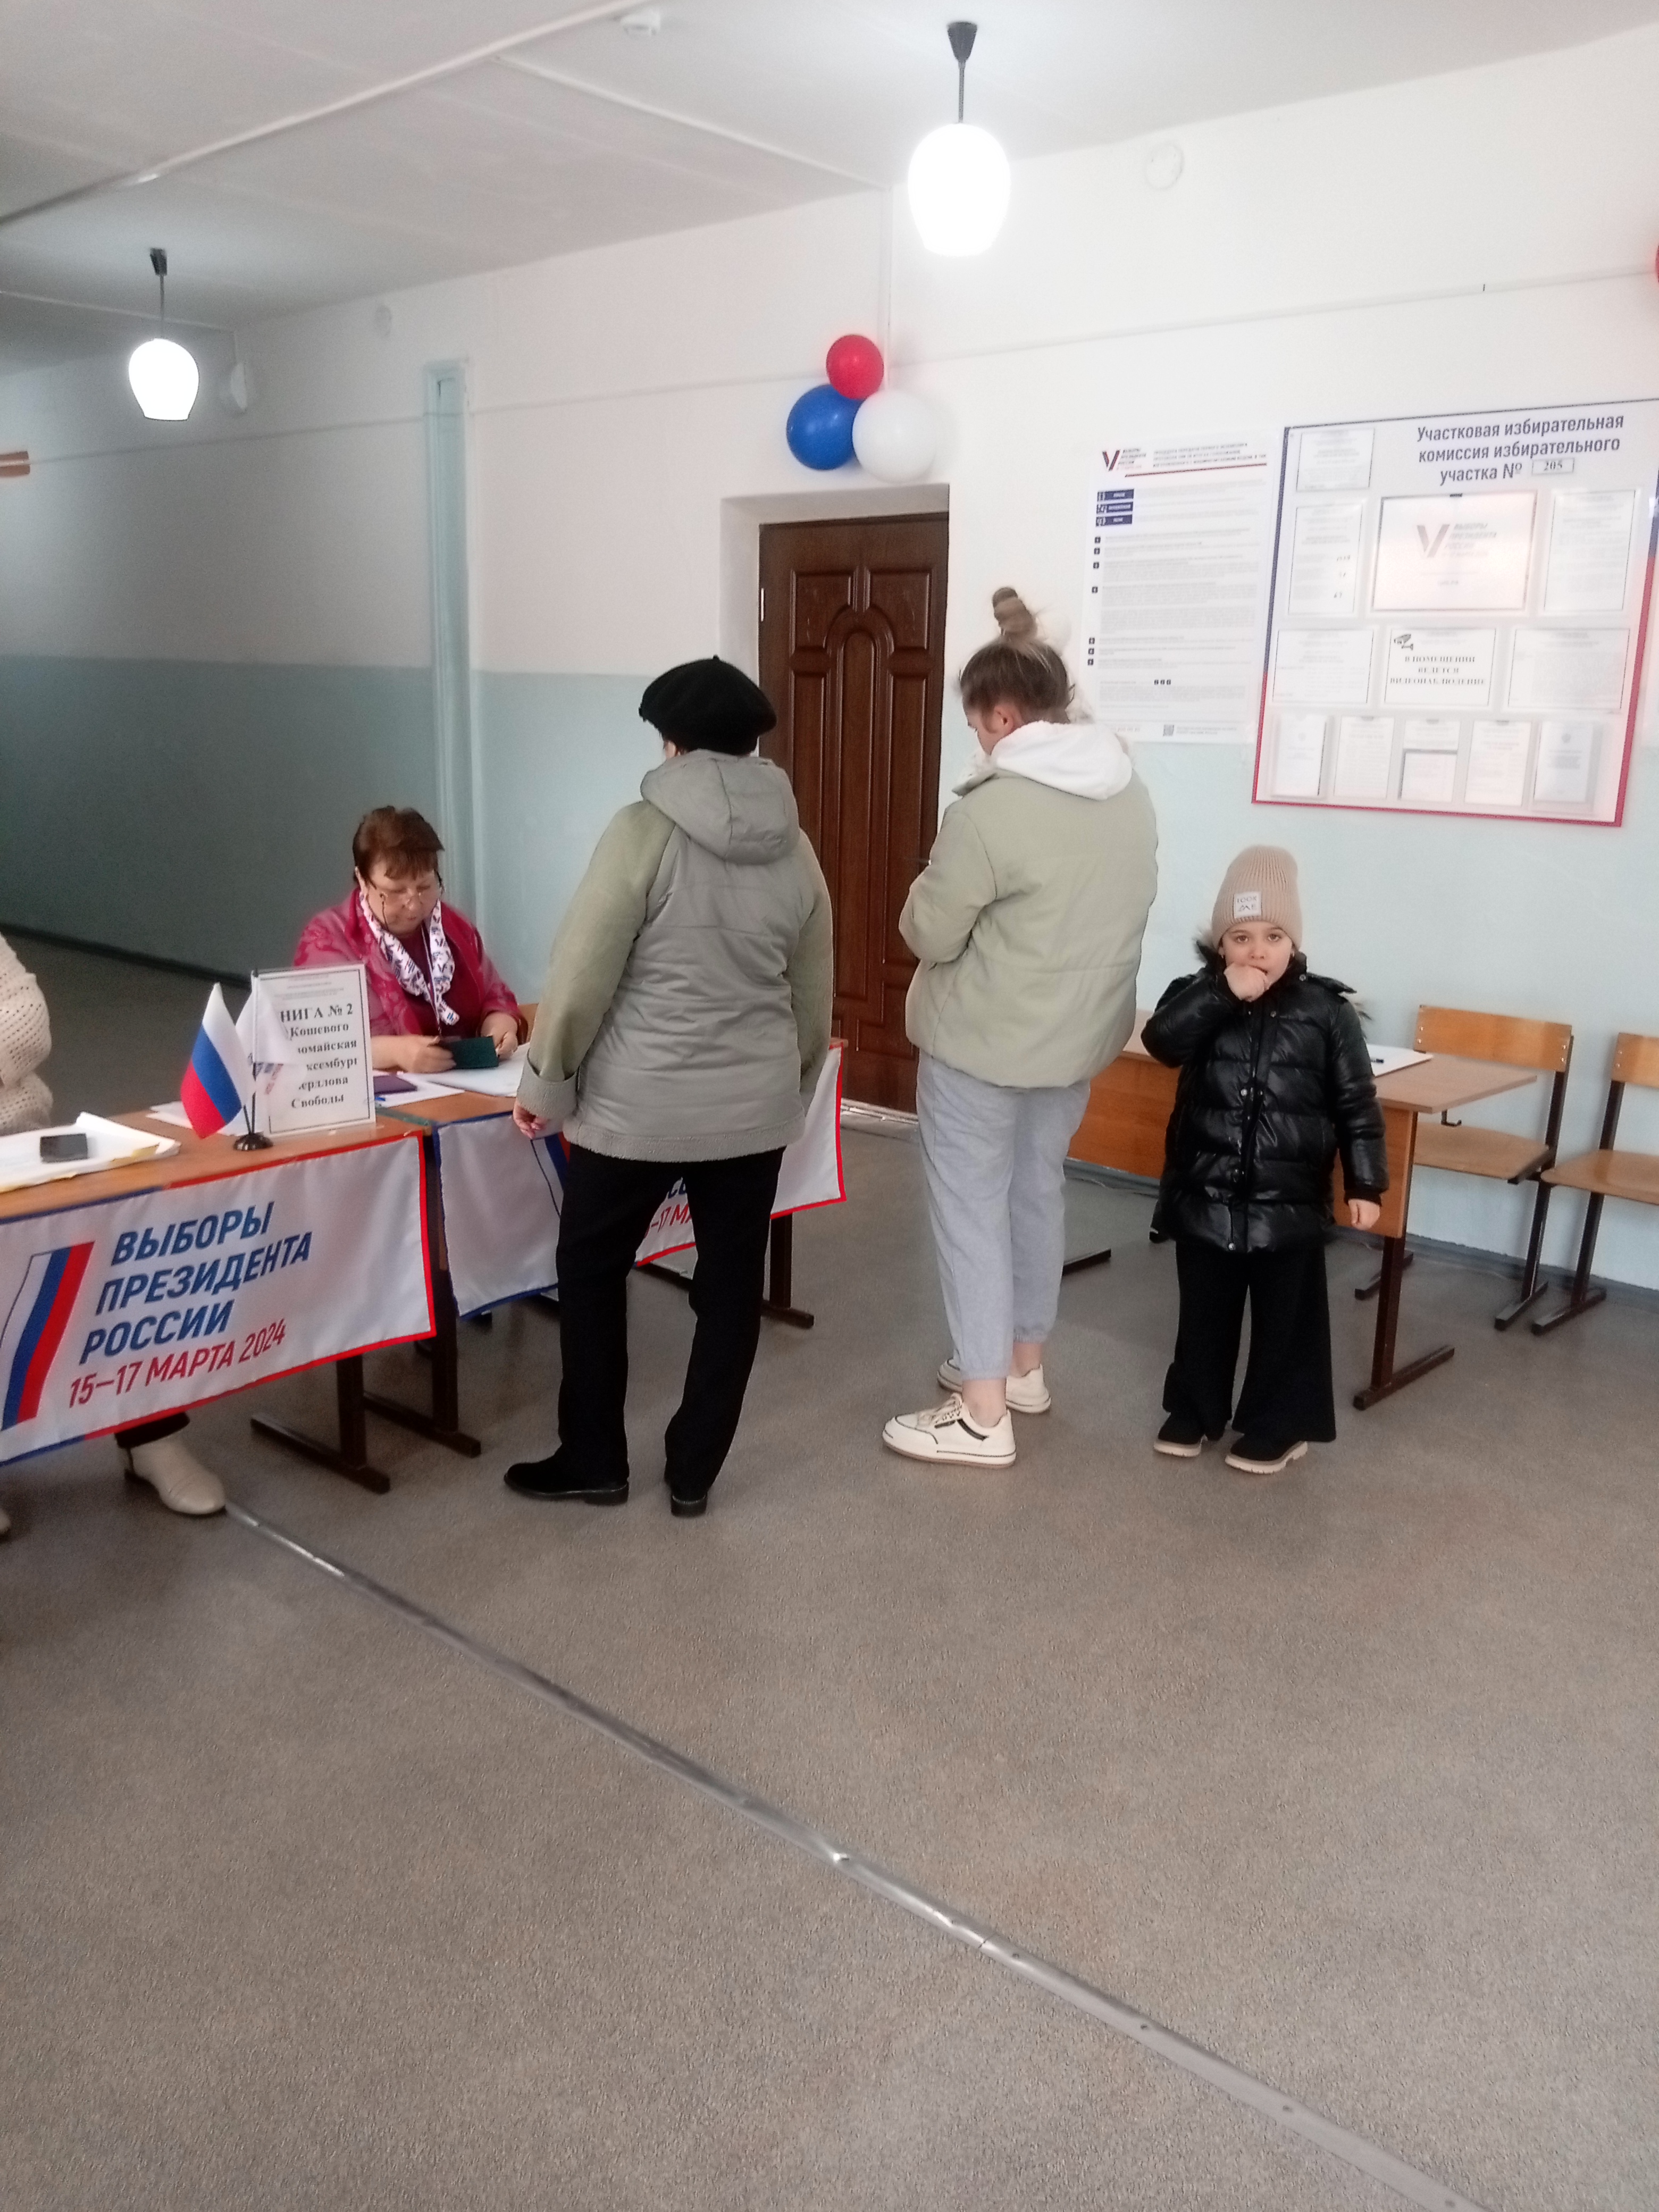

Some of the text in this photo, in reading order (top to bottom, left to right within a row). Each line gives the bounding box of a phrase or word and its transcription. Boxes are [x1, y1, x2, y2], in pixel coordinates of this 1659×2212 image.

[1417, 415, 1624, 442] Участковая избирательная
[1419, 438, 1621, 463] комиссия избирательного
[1440, 467, 1498, 487] участка
[1544, 459, 1563, 472] 205
[280, 1007, 323, 1023] НИГА
[346, 1003, 353, 1015] 2
[298, 1040, 357, 1054] омайская
[291, 1094, 344, 1109] Свободы
[110, 1201, 276, 1268] ВЫБОРЫ
[95, 1231, 313, 1316] ПРЕЗИДЕНТА
[79, 1299, 236, 1365] РОССИИ
[69, 1318, 287, 1409] 15–17 МАРТА 2024
